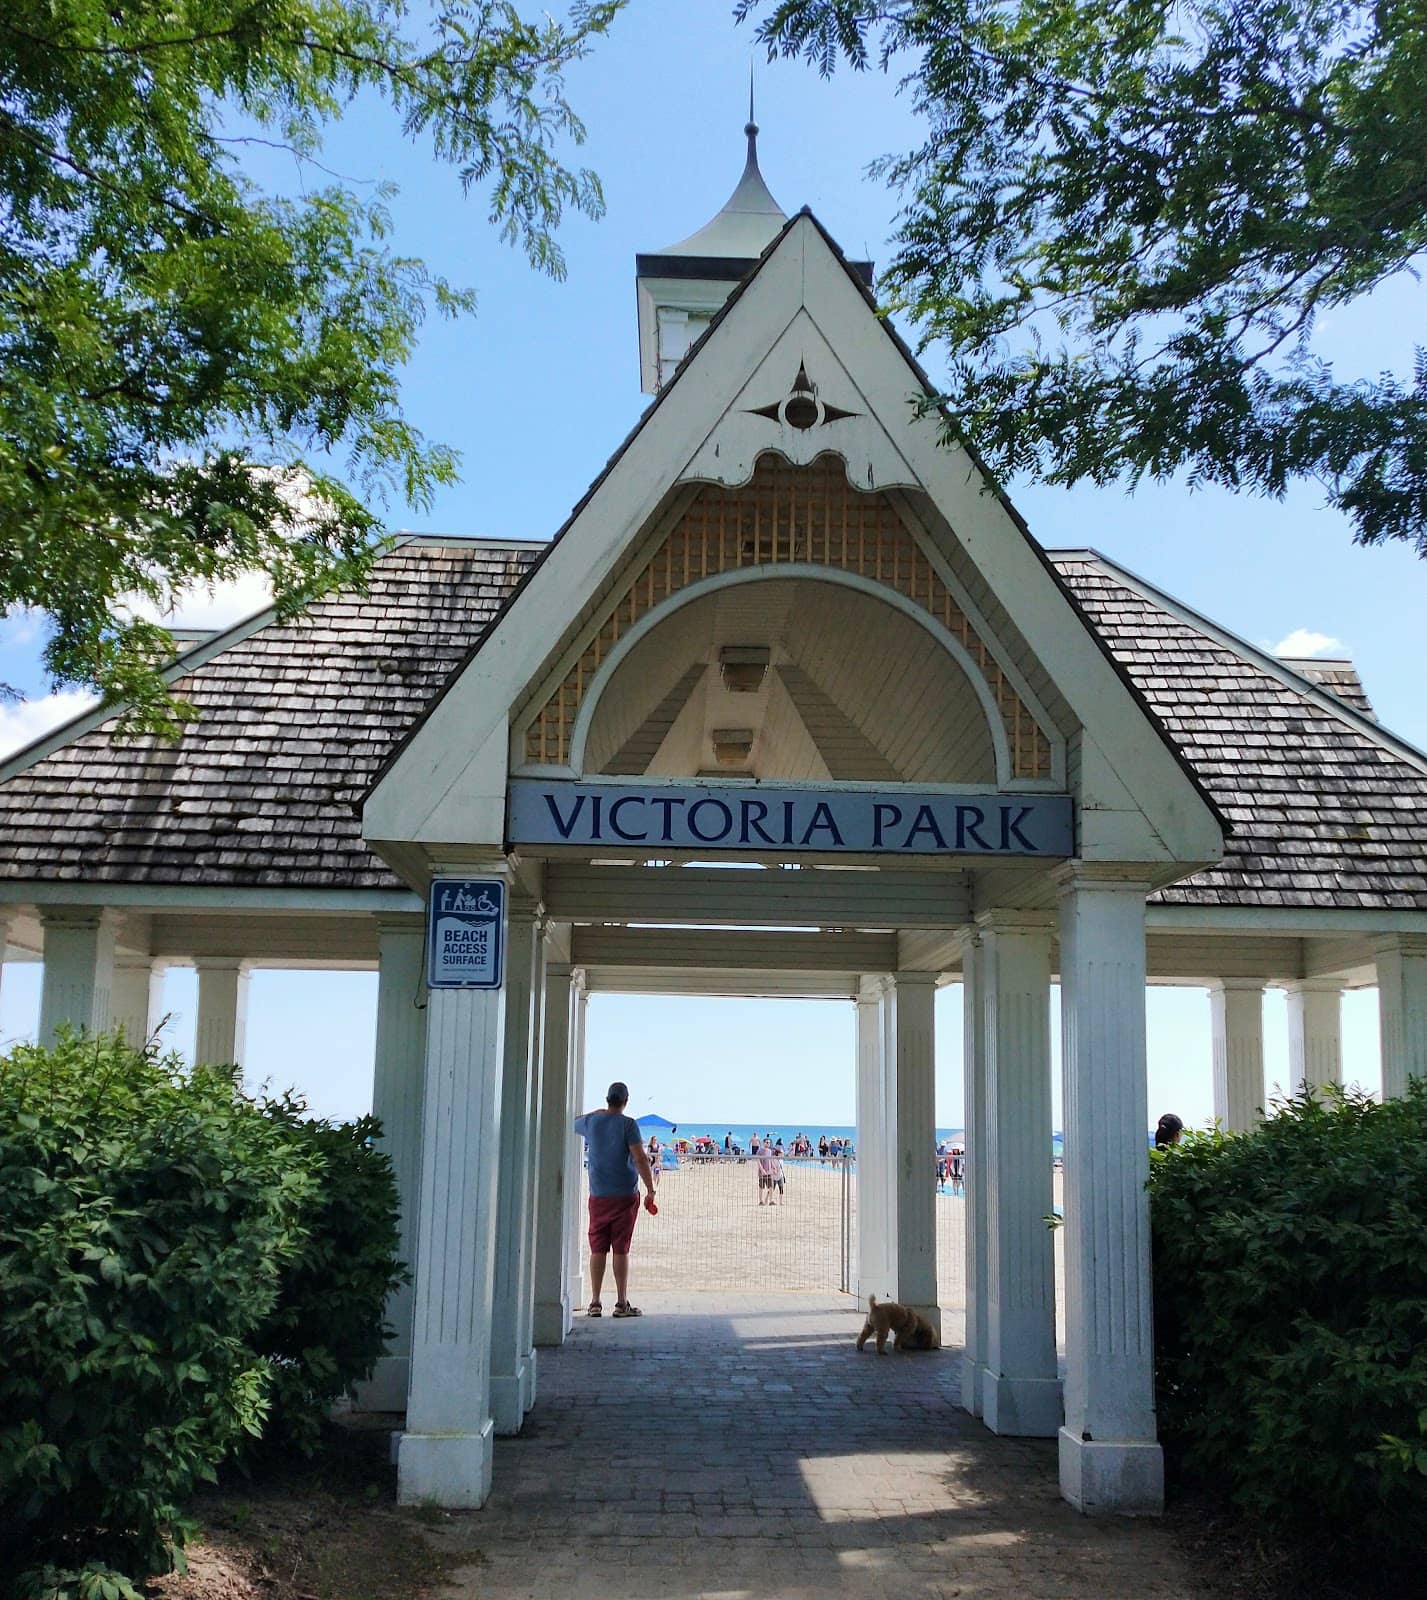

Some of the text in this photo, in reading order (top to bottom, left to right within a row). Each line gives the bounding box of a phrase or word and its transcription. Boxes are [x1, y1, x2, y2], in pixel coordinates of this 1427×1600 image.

[543, 794, 1040, 851] VICTORIA PARK
[444, 930, 488, 943] BEACH
[442, 943, 488, 954] ACCESS
[442, 955, 488, 965] SURFACE
